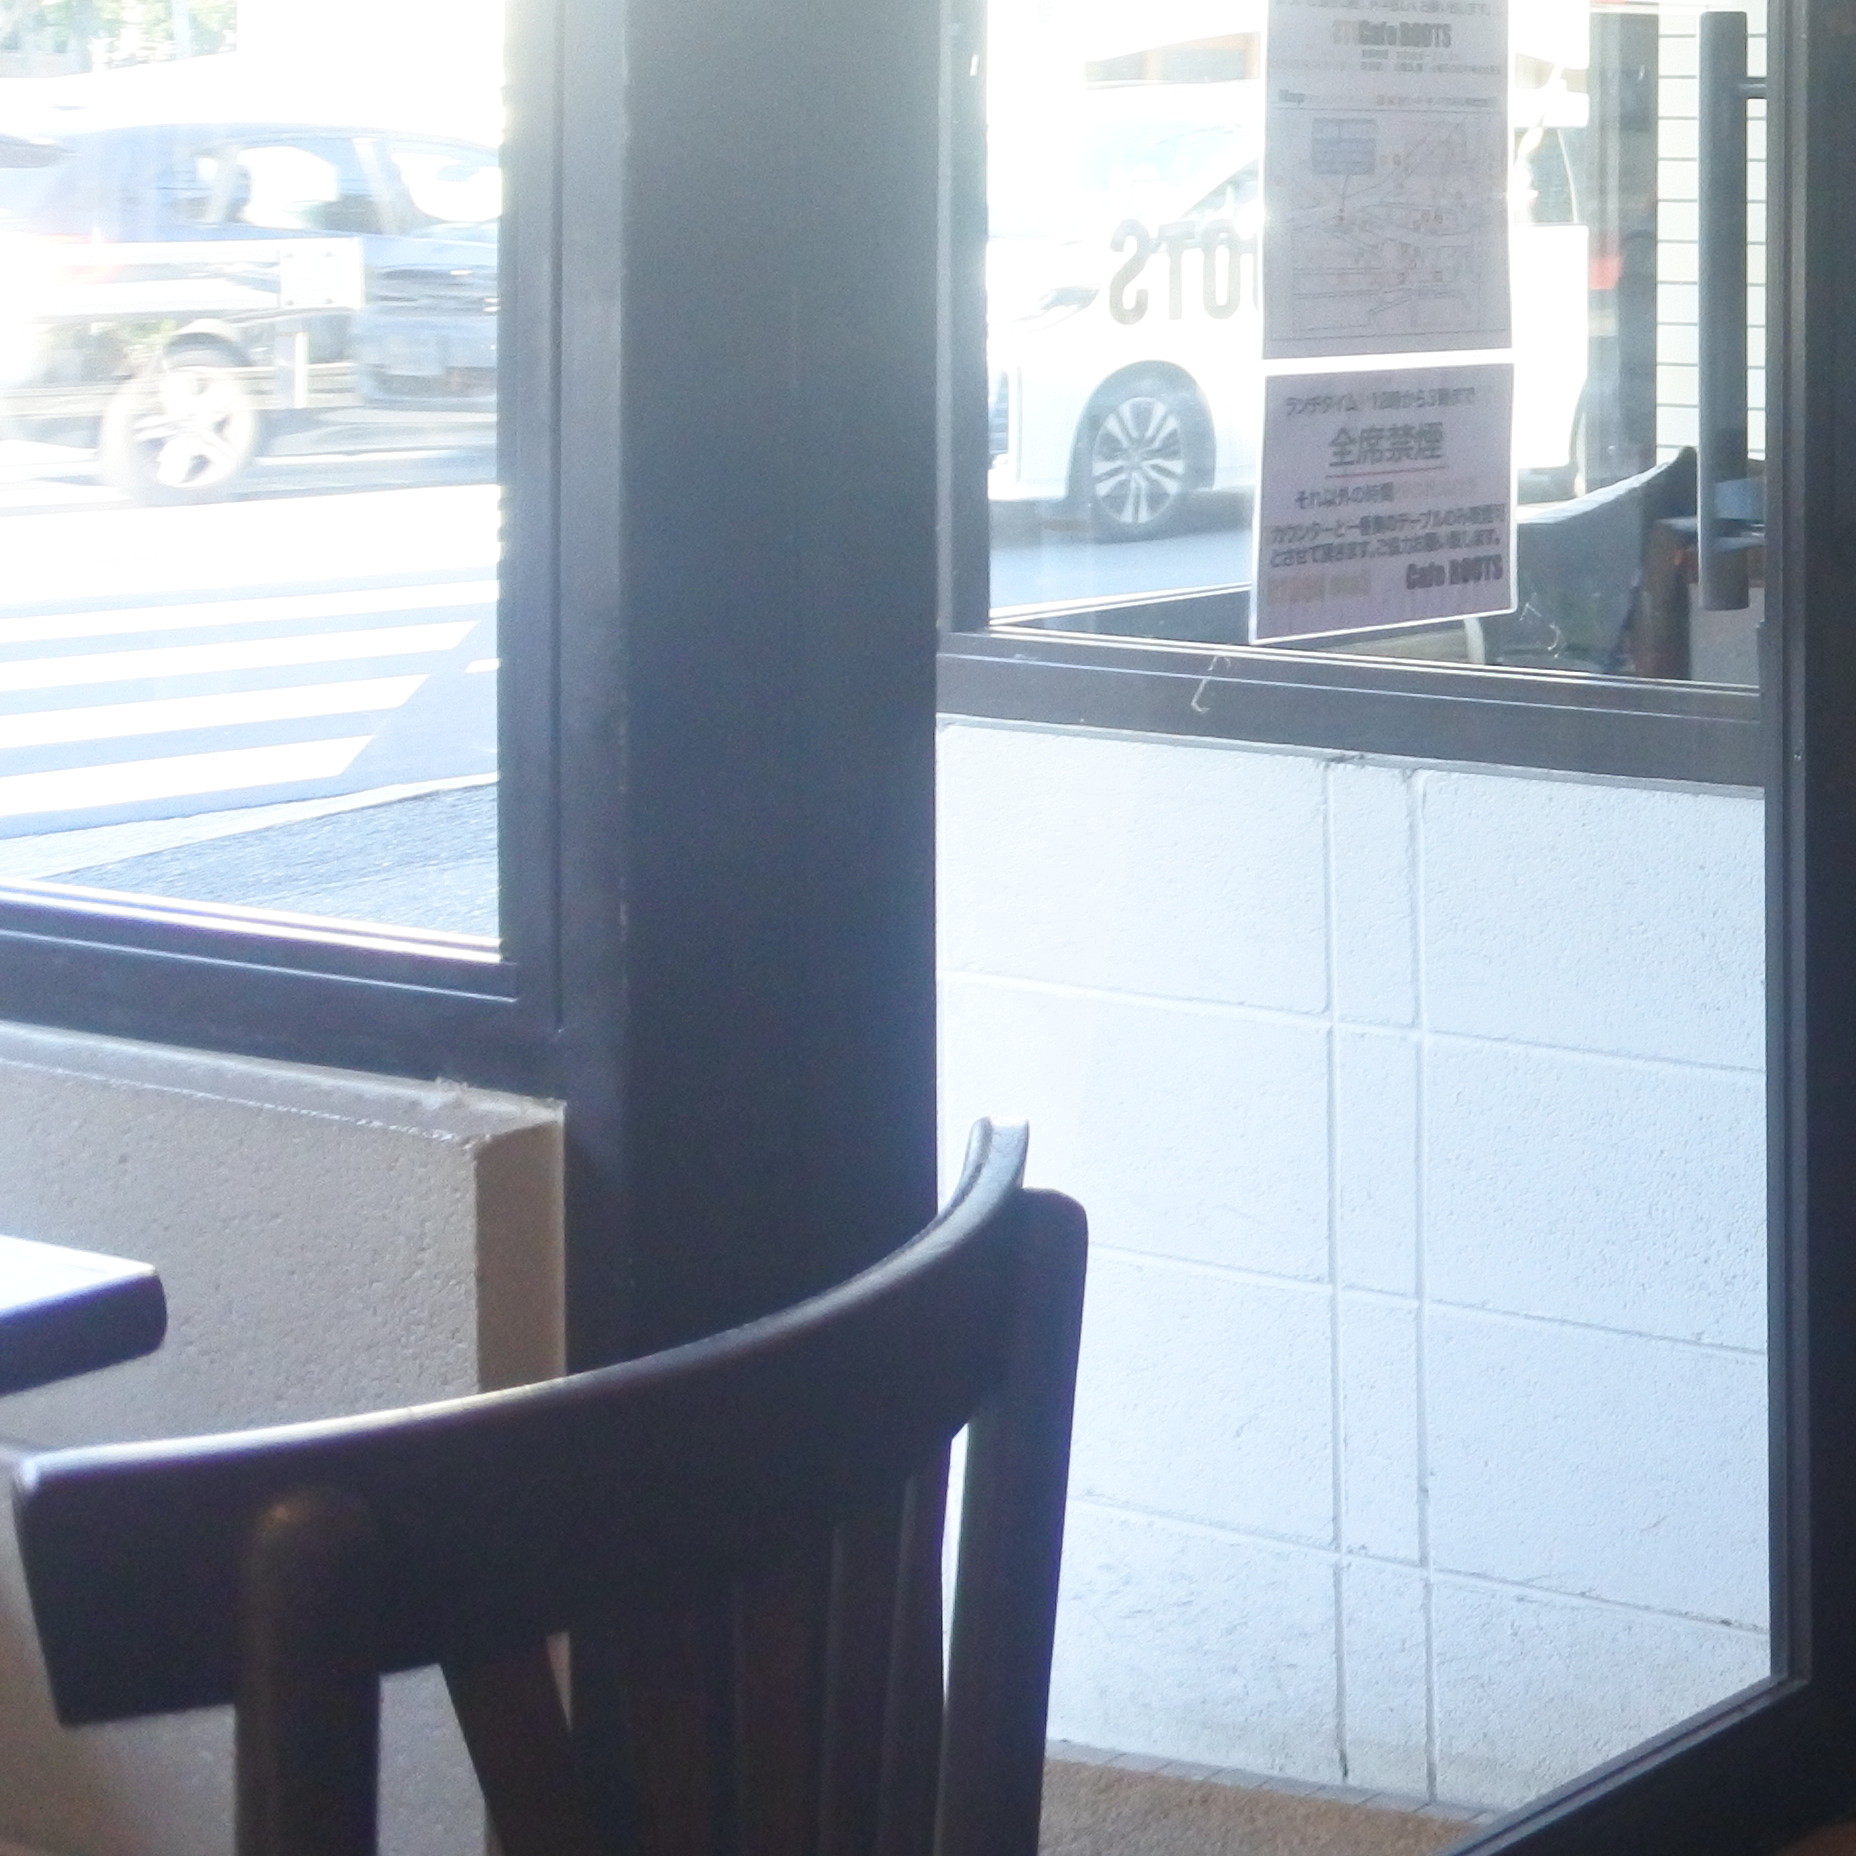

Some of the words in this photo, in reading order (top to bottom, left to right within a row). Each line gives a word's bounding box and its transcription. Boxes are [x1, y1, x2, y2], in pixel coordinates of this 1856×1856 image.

[1399, 22, 1452, 48] ROOTS
[1328, 421, 1444, 467] 全席禁煙
[1406, 561, 1446, 590] Cafe
[1449, 553, 1504, 585] ROOTS
